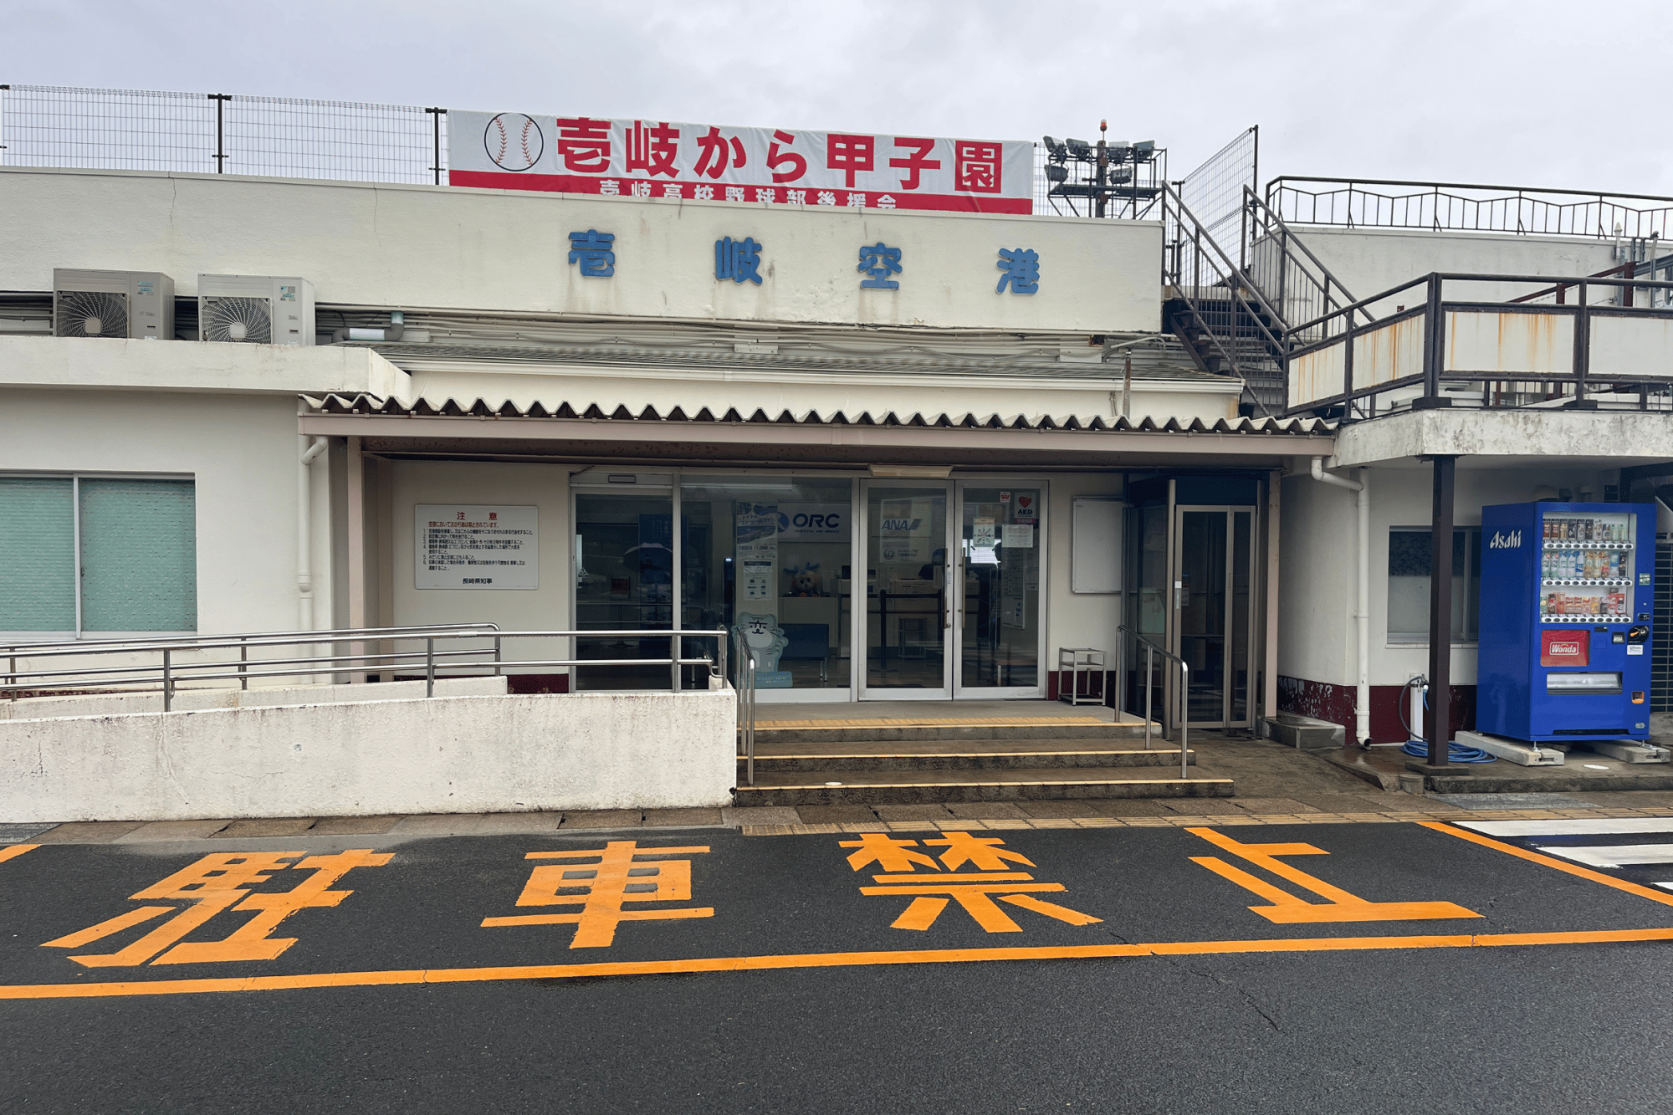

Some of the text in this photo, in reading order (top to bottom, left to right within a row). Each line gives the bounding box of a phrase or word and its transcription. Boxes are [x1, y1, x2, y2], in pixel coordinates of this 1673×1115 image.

[556, 116, 1002, 194] 壱岐から甲子園
[599, 179, 896, 209] 壱岐高校野球部後援会
[567, 228, 1040, 295] 壱岐空港
[792, 512, 840, 528] ORC
[881, 519, 909, 530] ANA
[1490, 529, 1522, 549] Asahi
[1551, 643, 1577, 653] Wonda
[39, 827, 1486, 968] 駐車禁止
